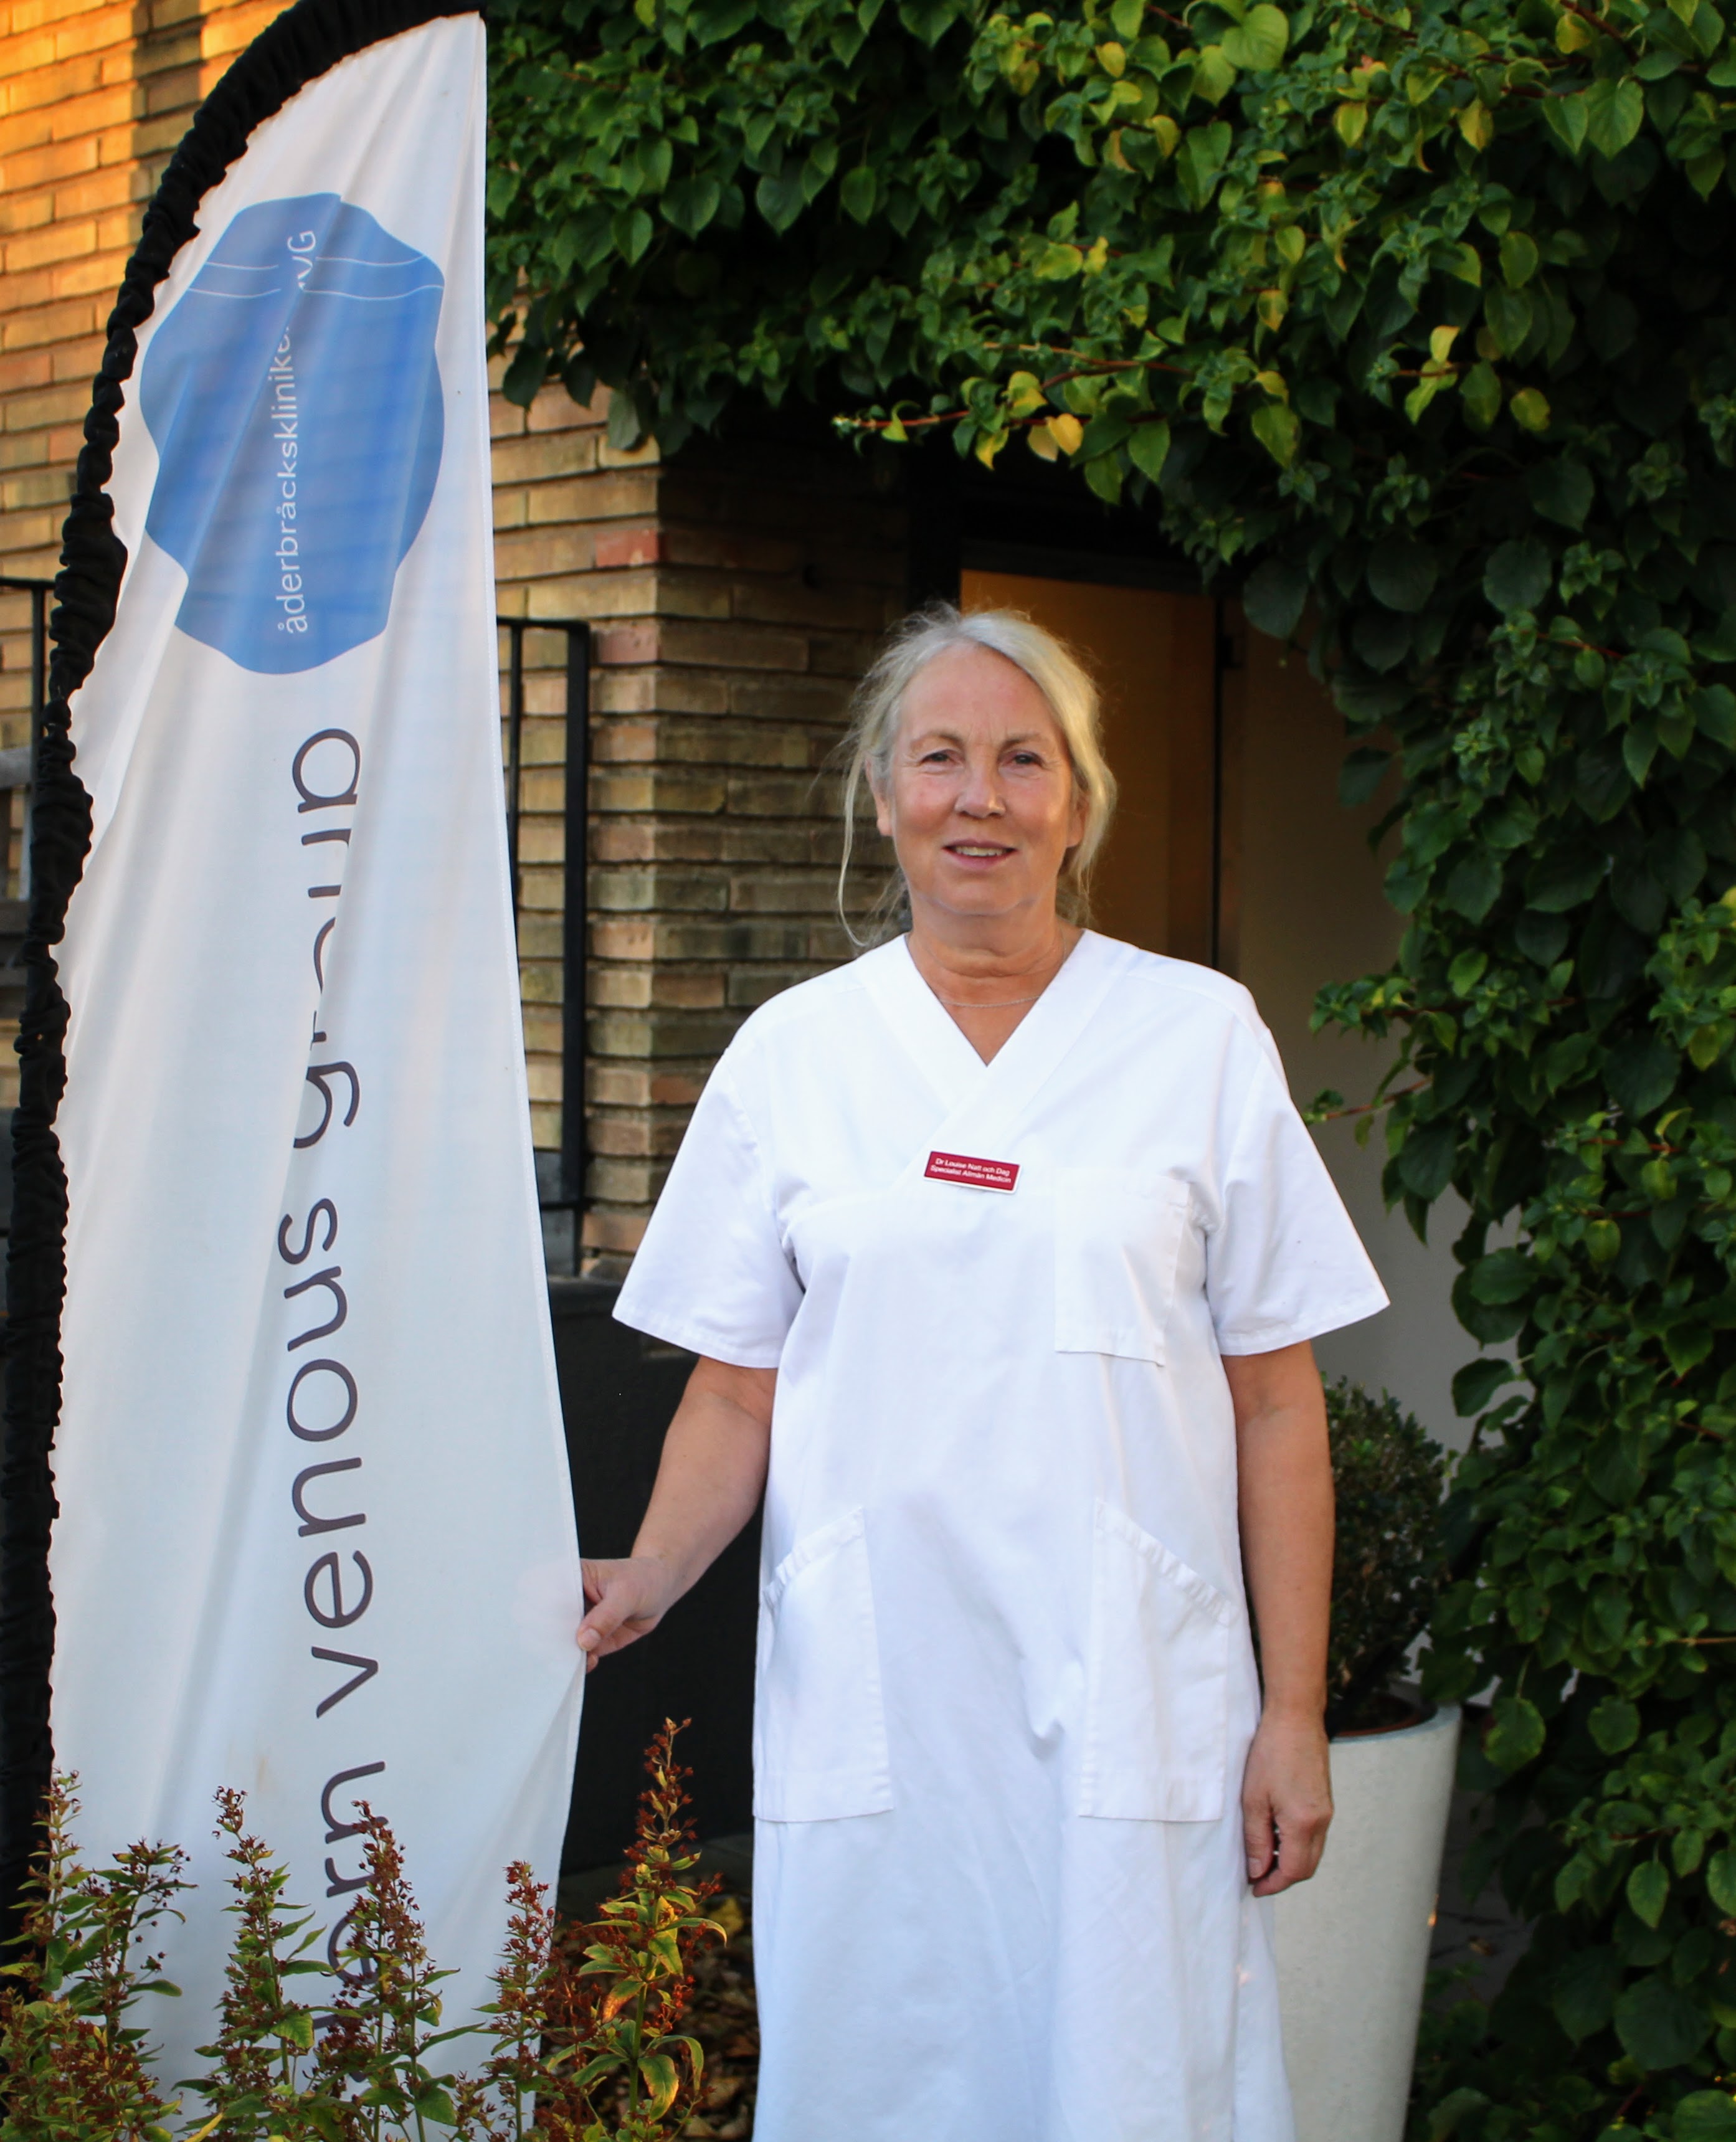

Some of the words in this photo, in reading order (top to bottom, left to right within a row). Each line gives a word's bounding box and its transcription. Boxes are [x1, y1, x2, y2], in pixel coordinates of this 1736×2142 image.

[287, 230, 316, 290] VG
[931, 1165, 962, 1175] Specialist
[986, 1174, 1012, 1183] Medicin
[935, 1157, 944, 1165] Dr
[945, 1160, 967, 1168] Louise
[996, 1167, 1010, 1176] Dag
[277, 1197, 379, 1719] venous
